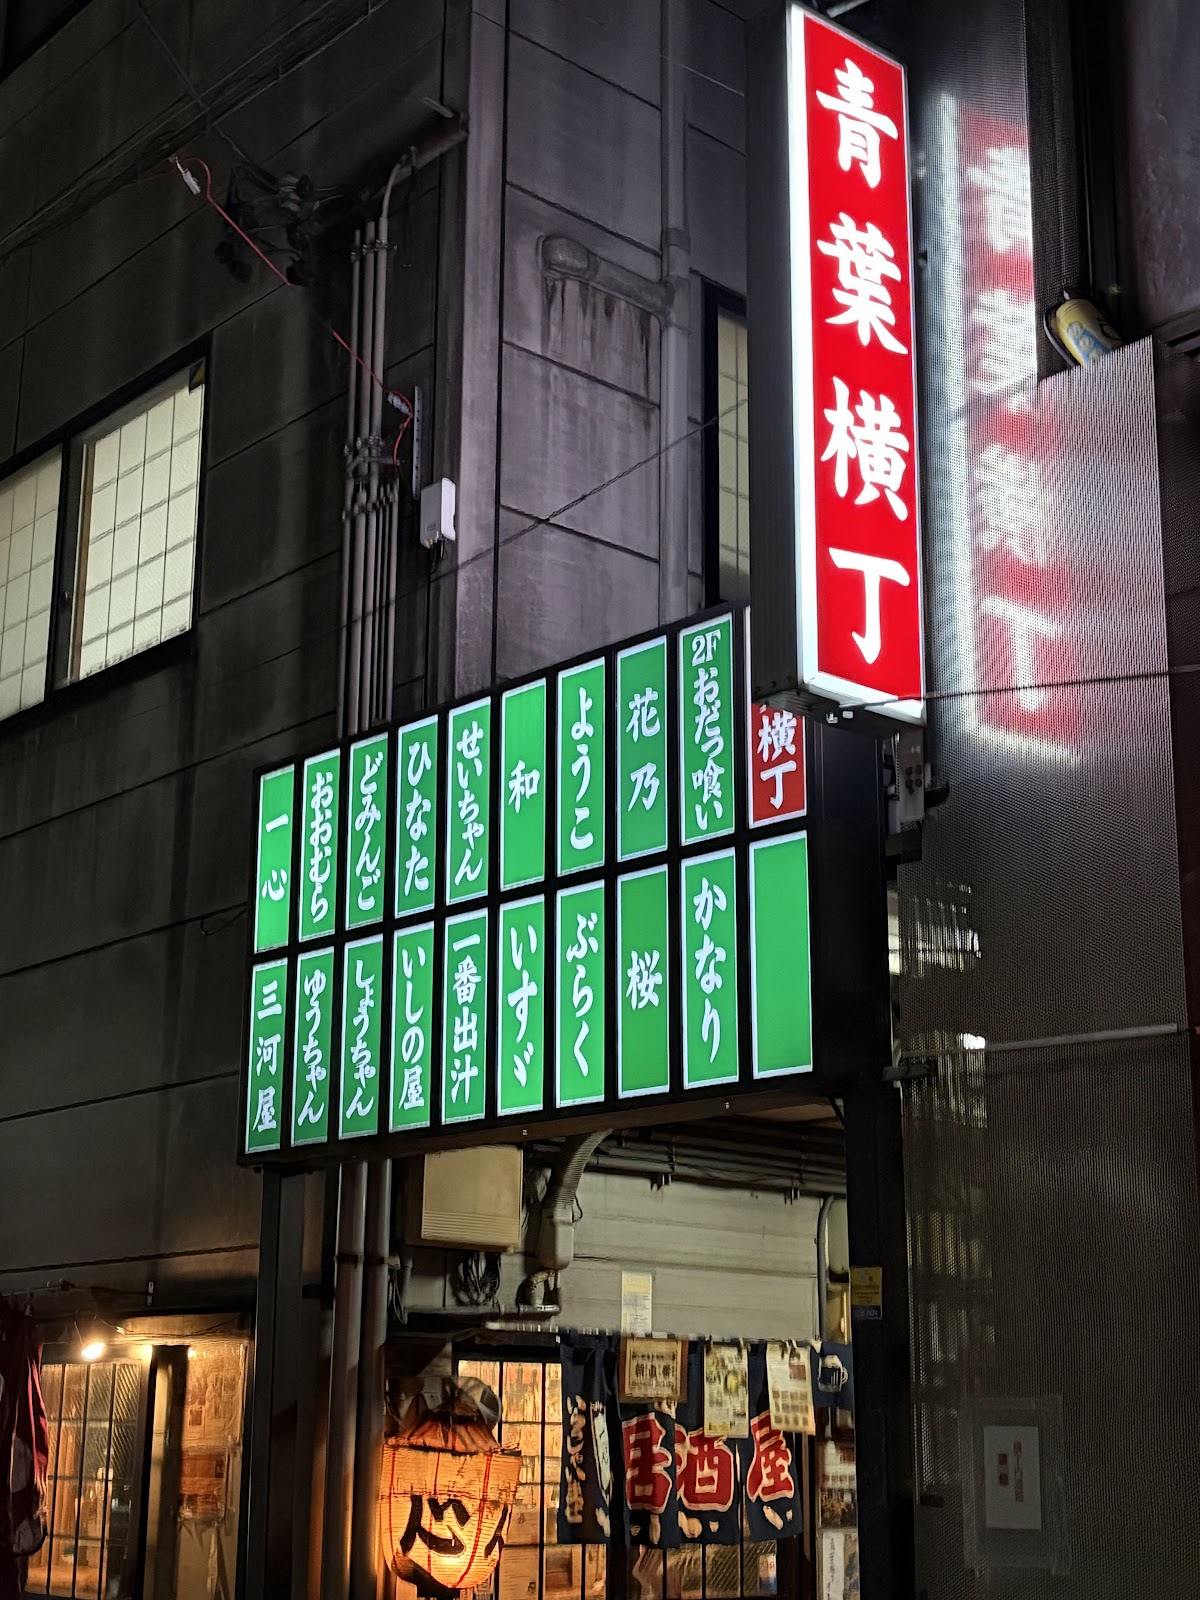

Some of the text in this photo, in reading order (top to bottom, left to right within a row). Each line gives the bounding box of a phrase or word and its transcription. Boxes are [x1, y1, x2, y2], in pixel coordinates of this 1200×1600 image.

[816, 58, 911, 665] 青葉横丁
[404, 741, 432, 897] ひなた
[454, 720, 485, 886] せいちゃん
[508, 759, 541, 815] 和
[570, 686, 595, 851] ようこ
[626, 686, 662, 812] 花乃
[756, 703, 798, 810] 横丁
[262, 814, 289, 901] 一心
[309, 771, 334, 924] おおむら
[354, 750, 385, 911] どみんご
[297, 968, 327, 1127] ゆうちゃん
[345, 958, 377, 1120] しょうちゃん
[398, 945, 427, 1111] いしの屋
[450, 933, 483, 1105] 一番出汁
[565, 911, 600, 1078] ぶらく
[626, 949, 664, 1012] 桜
[693, 876, 729, 1065] かなり
[252, 979, 283, 1134] 三河屋
